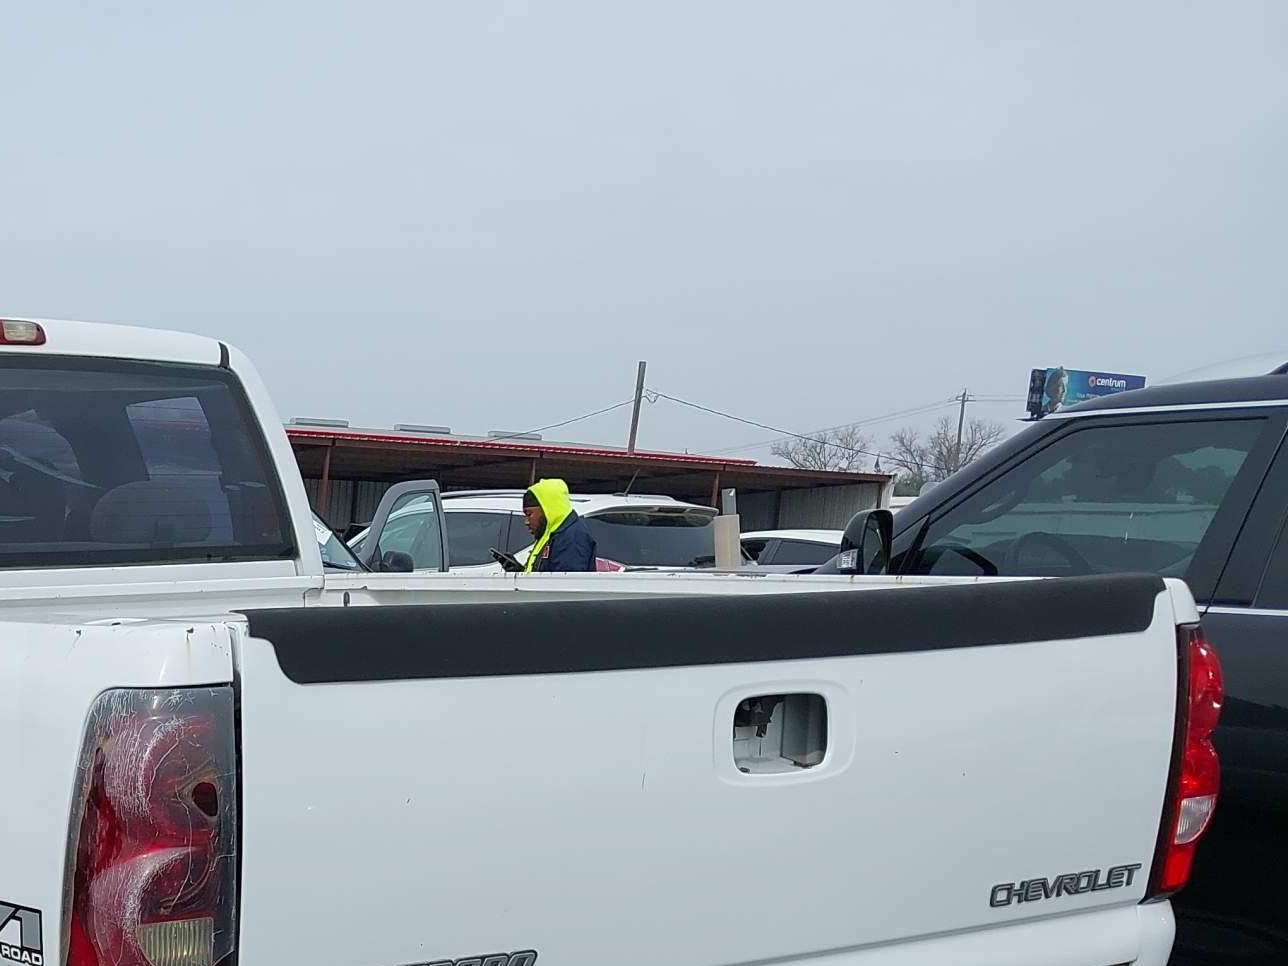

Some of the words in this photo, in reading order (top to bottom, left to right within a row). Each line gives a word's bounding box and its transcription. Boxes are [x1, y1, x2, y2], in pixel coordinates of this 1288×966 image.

[1096, 377, 1127, 388] centrum
[990, 863, 1142, 907] CHEVROLET
[1, 944, 43, 966] ROAD
